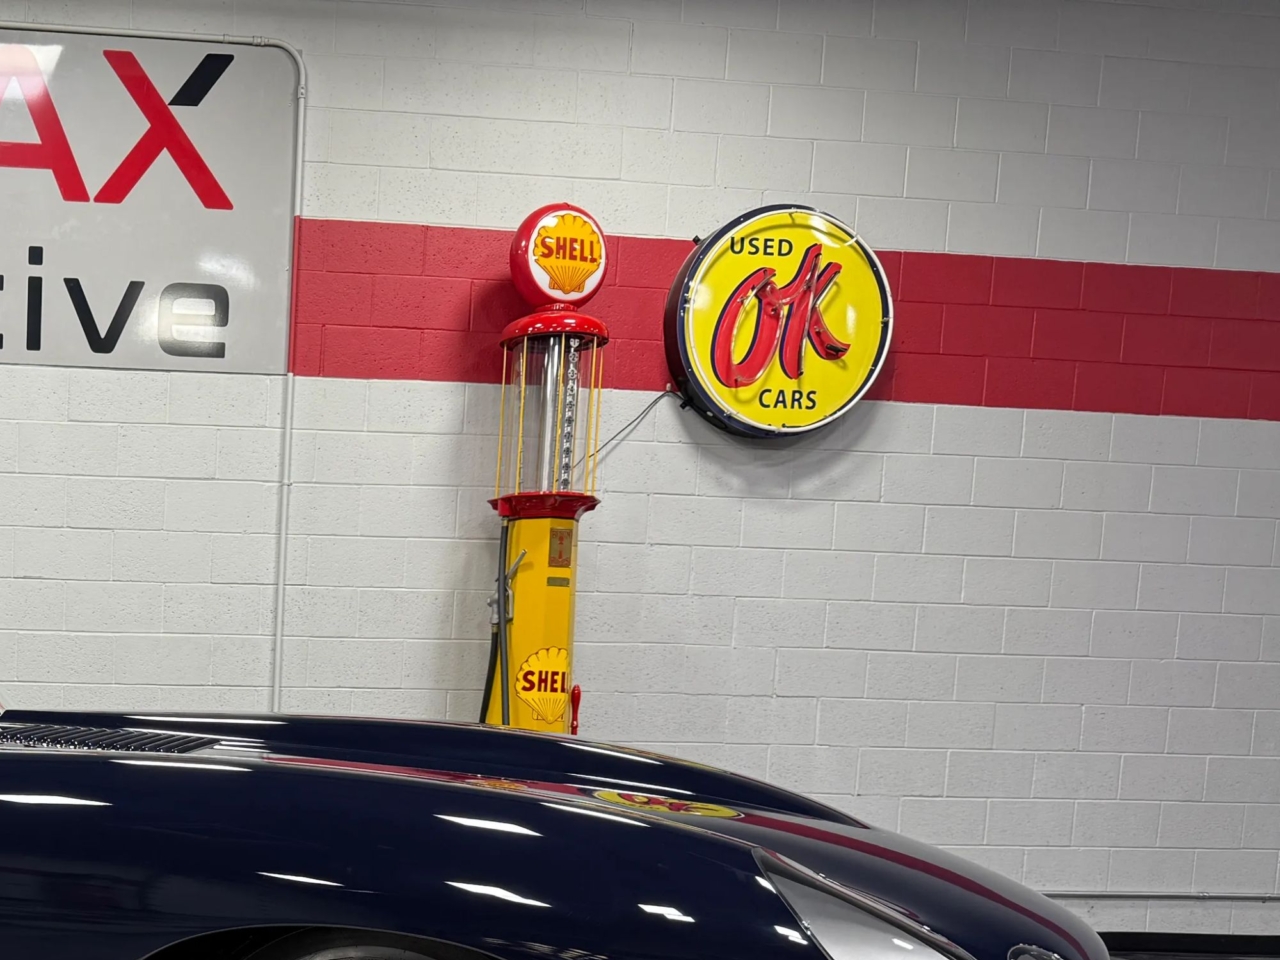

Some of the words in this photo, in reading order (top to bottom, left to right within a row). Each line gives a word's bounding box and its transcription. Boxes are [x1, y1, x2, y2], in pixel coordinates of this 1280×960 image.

[540, 235, 598, 263] SHELL
[730, 236, 793, 257] USED
[710, 243, 851, 388] OK
[758, 388, 817, 410] CARS
[521, 670, 568, 694] SHEL
